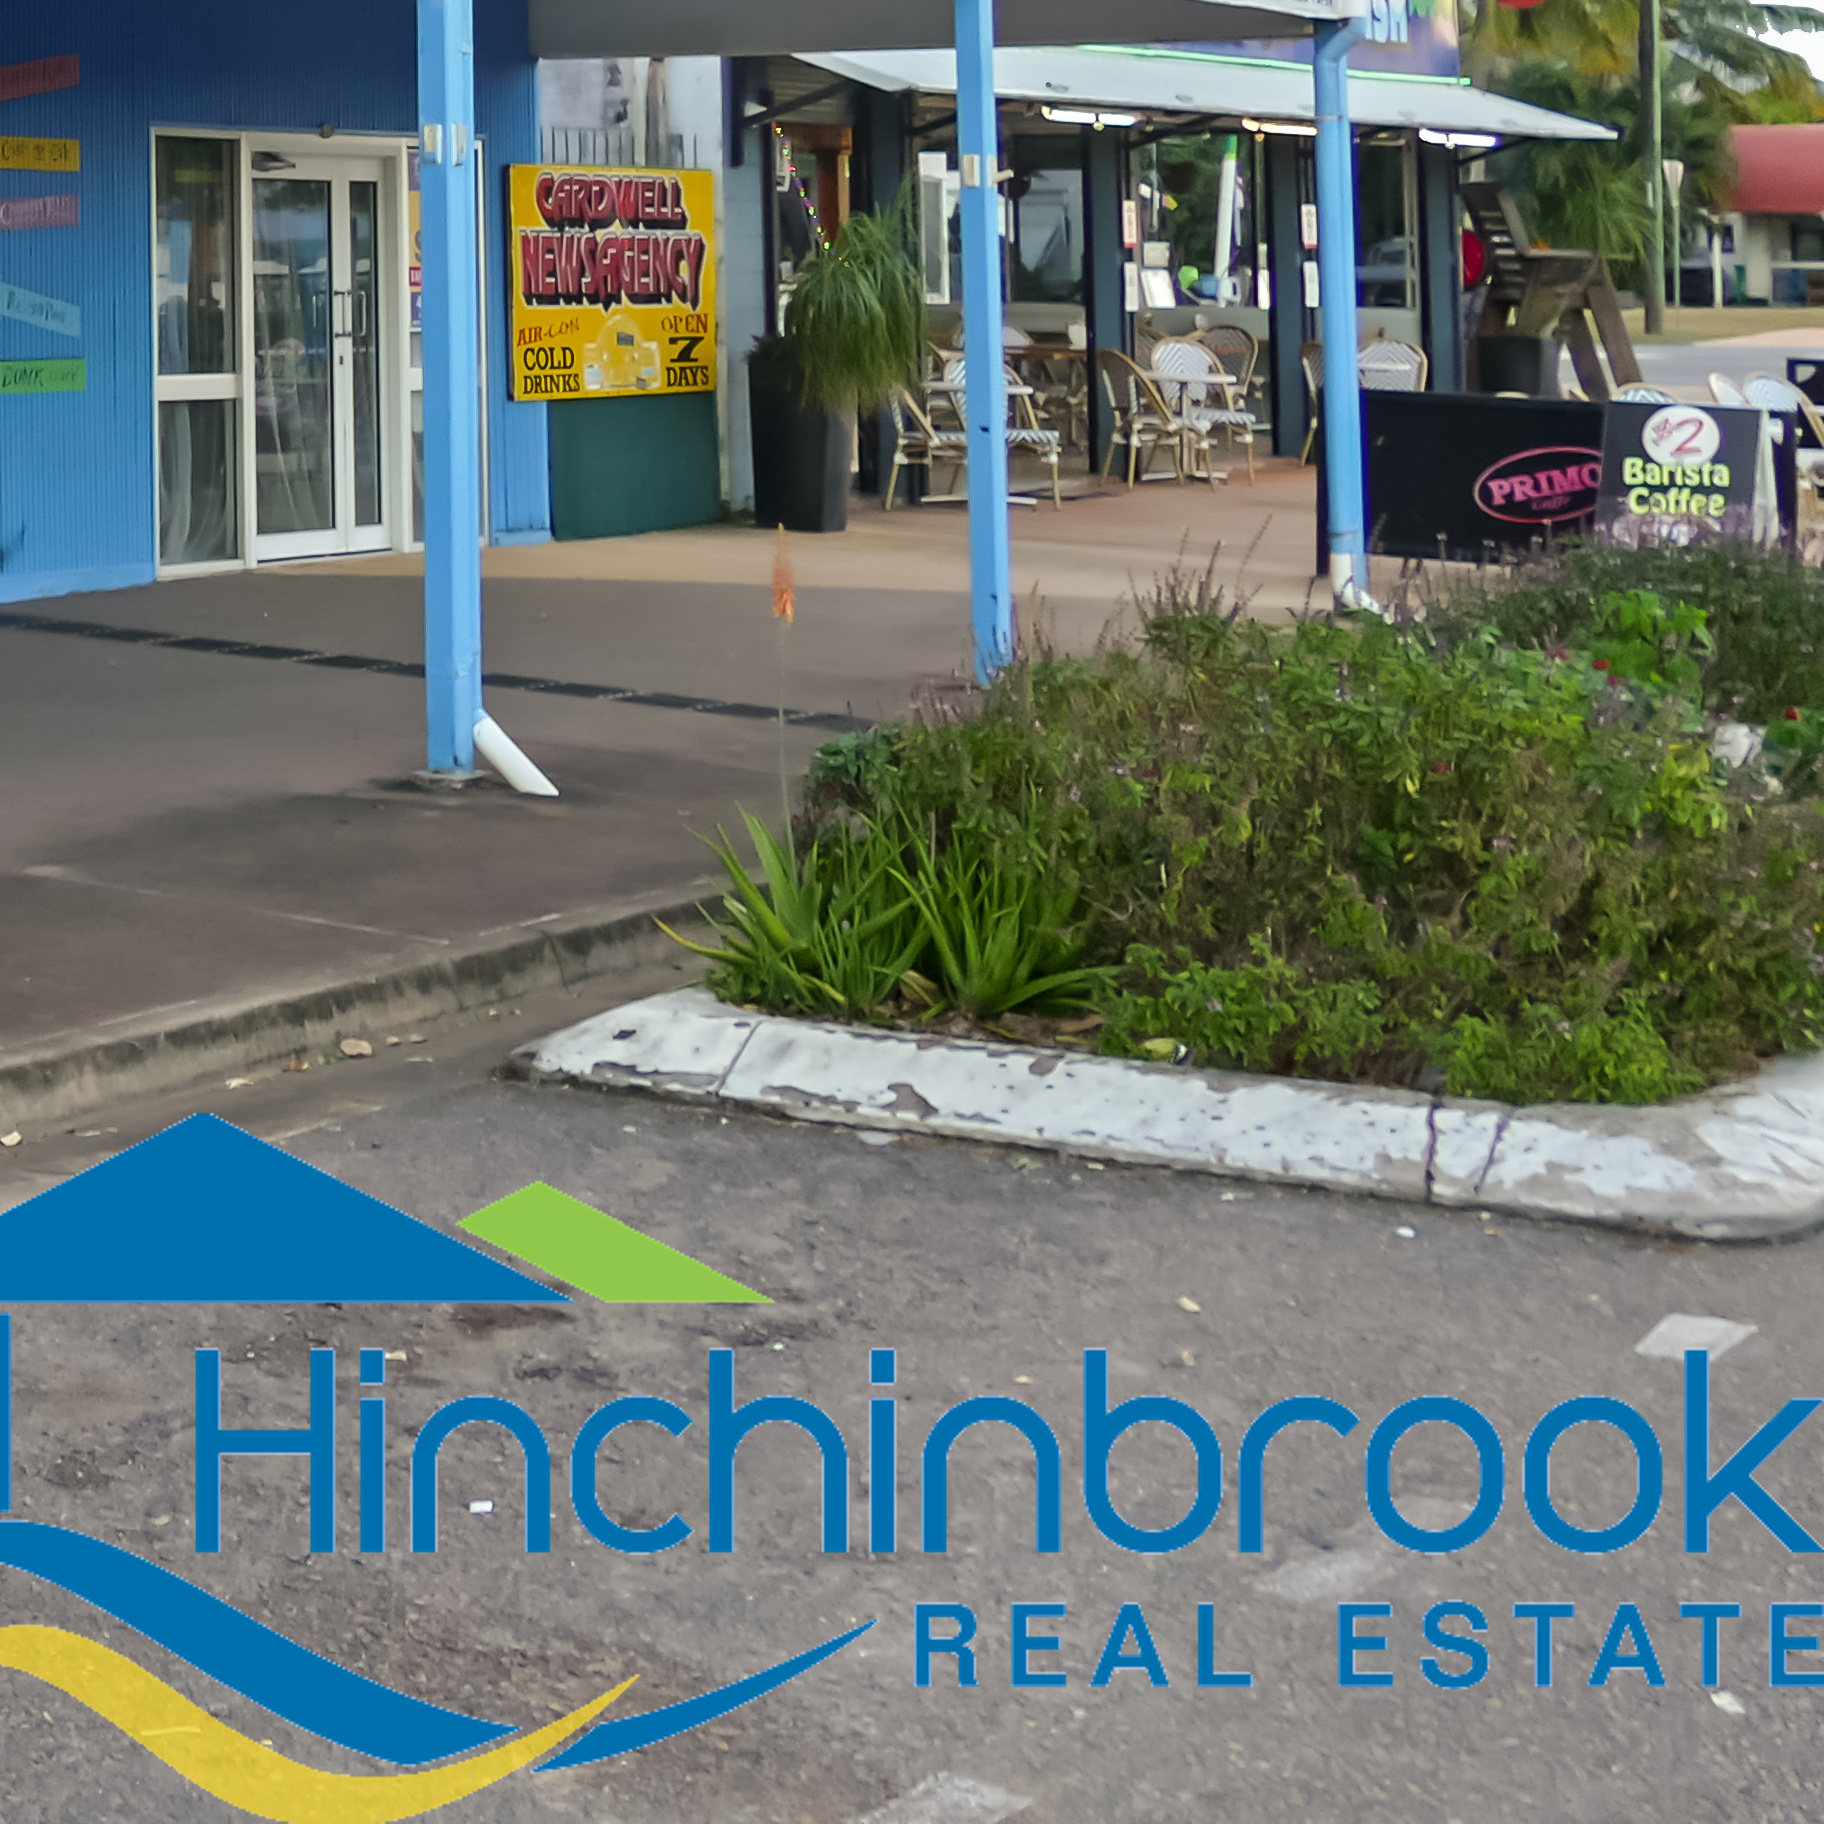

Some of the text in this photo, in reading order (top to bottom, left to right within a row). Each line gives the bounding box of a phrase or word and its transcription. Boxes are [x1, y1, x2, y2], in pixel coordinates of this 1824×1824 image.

[536, 172, 689, 231] CARDWELL
[520, 229, 706, 313] NEWSAGENCY
[660, 313, 709, 334] OPEN
[523, 346, 575, 371] COLD
[668, 336, 705, 363] 7
[523, 373, 581, 395] DRINKS
[666, 365, 709, 388] DAYS
[1622, 456, 1731, 488] Barista
[1628, 487, 1727, 517] Coffee
